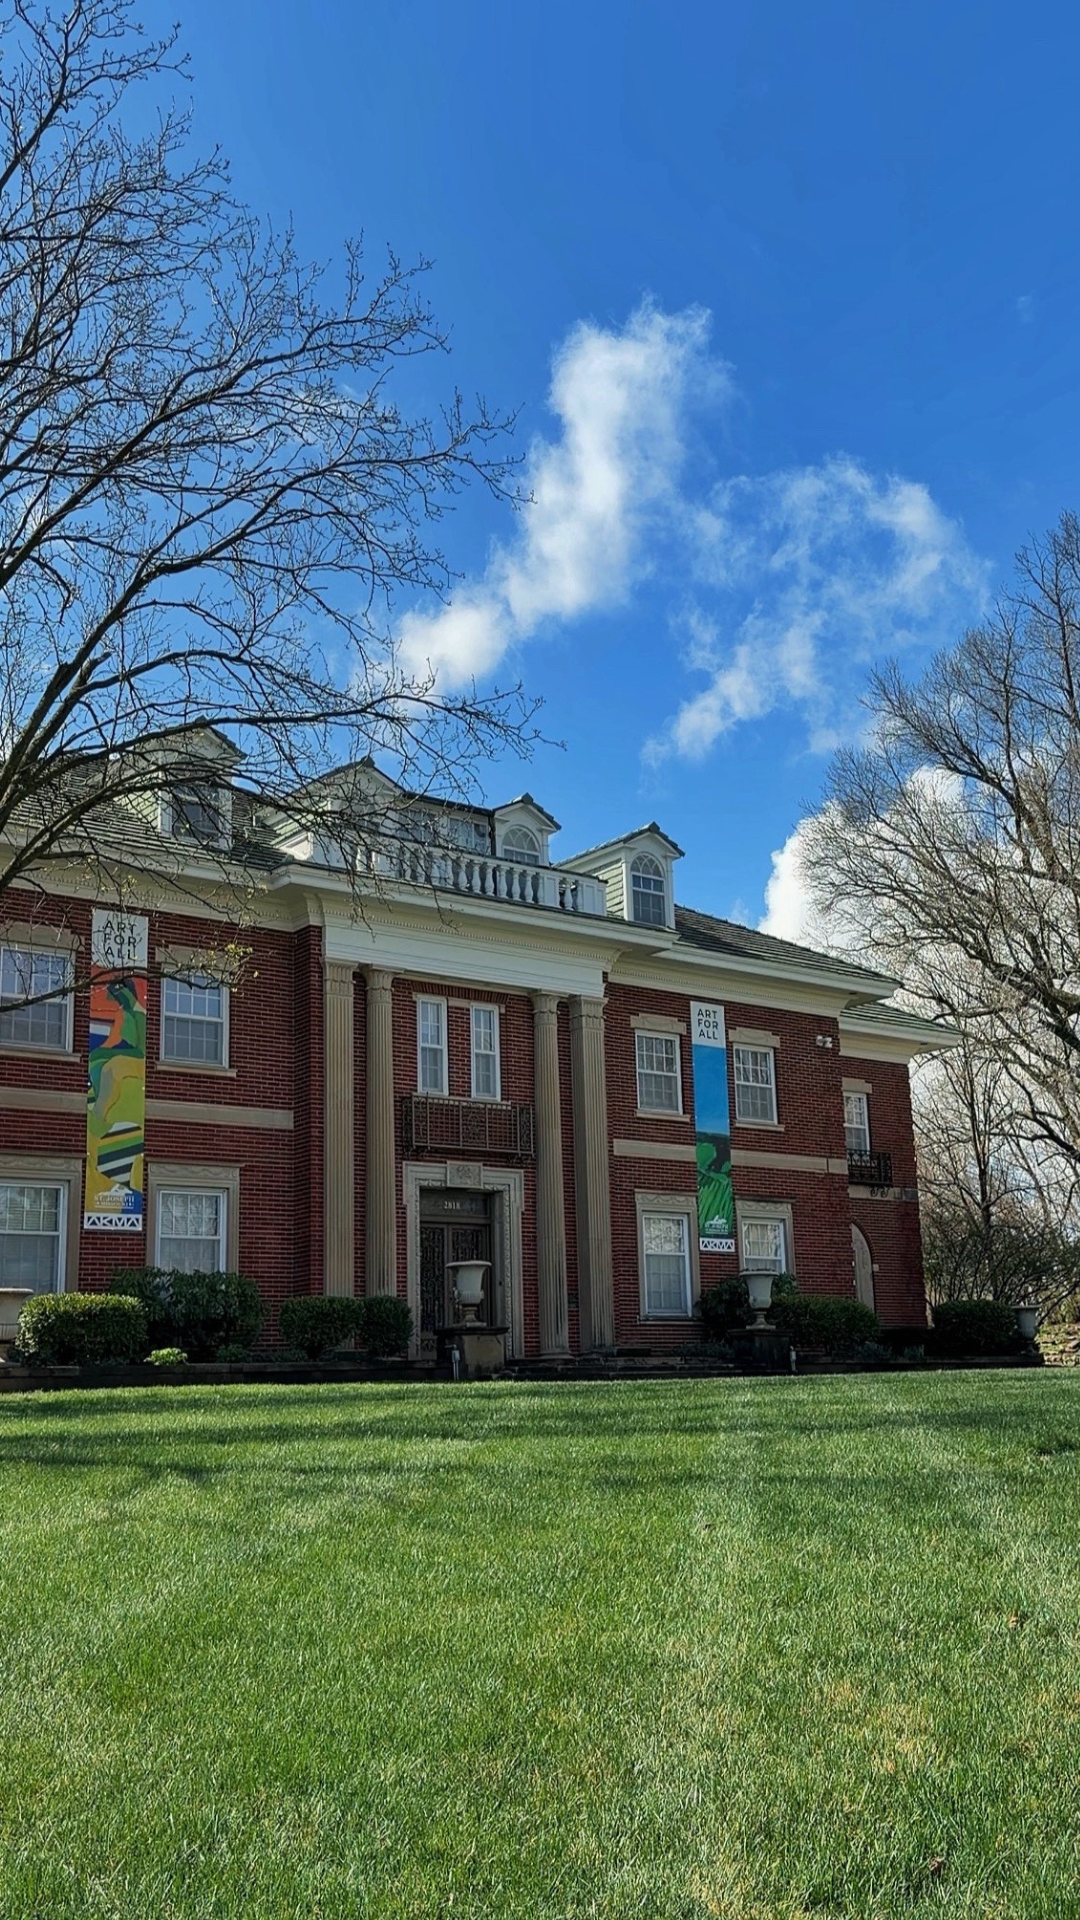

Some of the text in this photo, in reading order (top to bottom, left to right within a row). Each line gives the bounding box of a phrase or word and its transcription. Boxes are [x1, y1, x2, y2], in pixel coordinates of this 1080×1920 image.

[104, 921, 137, 935] ART
[104, 933, 137, 947] FOR
[105, 946, 137, 960] ALL
[697, 1008, 718, 1019] ART
[697, 1018, 719, 1030] FOR
[698, 1029, 718, 1040] ALL
[87, 1215, 140, 1228] AKMA
[701, 1239, 734, 1250] AKMA
